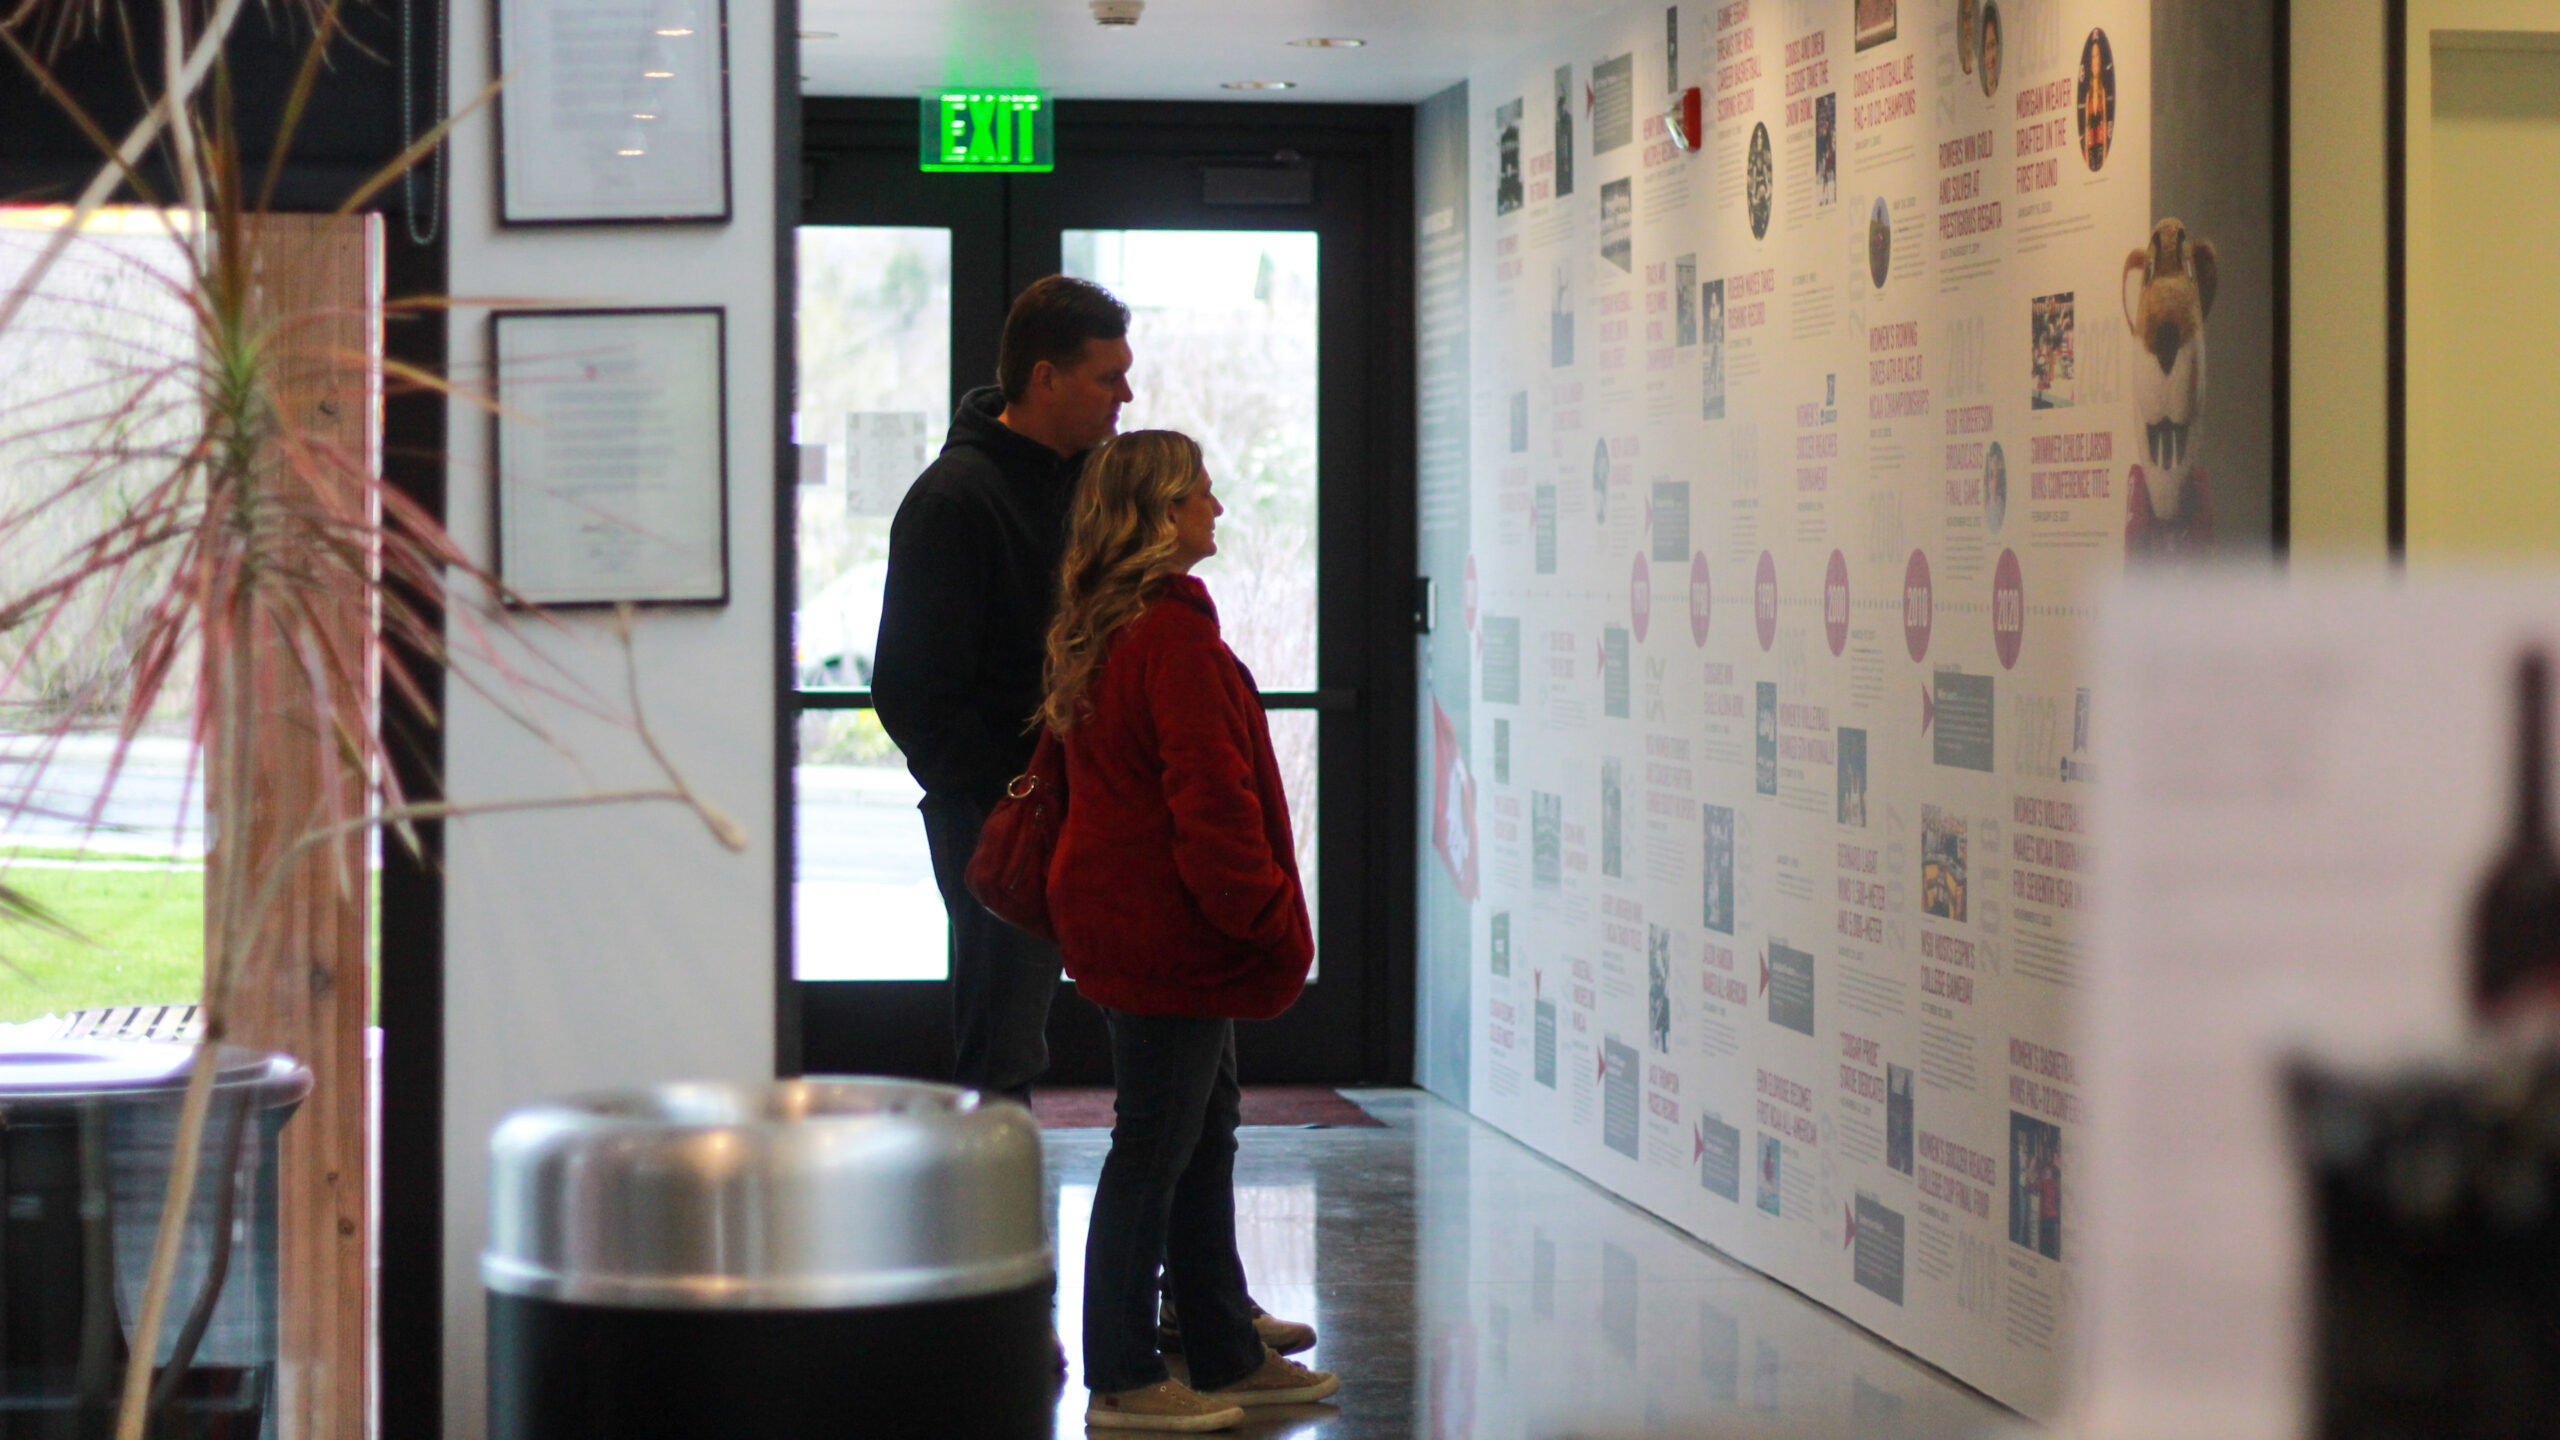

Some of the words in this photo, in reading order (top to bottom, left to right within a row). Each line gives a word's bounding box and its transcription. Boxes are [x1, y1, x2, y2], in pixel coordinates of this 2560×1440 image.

[1854, 69, 1875, 98] COUGAR
[1876, 60, 1902, 91] FOOTBALL
[1903, 54, 1914, 82] ARE
[2016, 87, 2044, 121] MORGAN
[2045, 77, 2072, 113] WEAVER
[941, 94, 1039, 164] EXIT
[2016, 123, 2045, 158] DRAFTED
[2046, 121, 2053, 151] IN
[2054, 117, 2067, 150] THE
[1938, 139, 1963, 169] ROWERS
[1964, 135, 1976, 164] WIN
[1977, 130, 1993, 160] GOLD
[1939, 177, 1951, 205] AND
[1951, 171, 1972, 203] SILVER
[1973, 169, 1981, 198] AT
[2016, 163, 2035, 194] FIRST
[2035, 157, 2058, 193] ROUND
[1938, 206, 1977, 241] PRESTIGIOUS
[1977, 201, 2003, 234] REGATTA
[1869, 324, 1895, 354] WOMEN'S
[1895, 320, 1918, 349] ROWING
[1869, 359, 1887, 387] TAKES
[1898, 355, 1915, 384] PLACE
[1916, 354, 1923, 381] AT
[1884, 389, 1930, 419] CHAMPIONSHIPS
[1945, 408, 1958, 435] BOB
[1958, 404, 1994, 434] ROBERTSON
[1945, 443, 1984, 471] BROADCASTS
[2031, 435, 2062, 464] SWIMMER
[2063, 433, 2085, 463] CHLOE
[2085, 431, 2113, 462] LARSON
[1945, 479, 1962, 506] FINAL
[1962, 478, 1982, 505] GAME
[2031, 471, 2048, 499] WINS
[2048, 469, 2091, 499] CONFERENCE
[2091, 468, 2111, 499] TITLE
[1757, 582, 1775, 619] 1990
[1827, 584, 1846, 623] 2000
[1906, 587, 1929, 627] 2010
[1996, 588, 2021, 632] 2020
[2014, 795, 2044, 828] WOMEN'S
[1837, 842, 1864, 872] BERNARD
[1864, 848, 1878, 875] LAGAT
[2013, 832, 2035, 864] MAKES
[2035, 835, 2053, 866] NCAA
[1837, 876, 1850, 904] WINS
[2013, 869, 2026, 902] FOR
[2026, 871, 2055, 907] SEVENTH
[2056, 876, 2074, 910] YEAR
[1837, 908, 1849, 936] AND
[1921, 929, 1933, 957] WSU
[1934, 933, 1952, 962] HOSTS
[1952, 938, 1976, 969] ESPN'S
[1921, 964, 1946, 997] COLLEGE
[1946, 973, 1974, 1006] GAMEDAY
[2009, 1037, 2038, 1071] WOMEN'S
[2009, 1073, 2026, 1105] WINS
[1918, 1130, 1944, 1164] WOMEN'S
[1944, 1136, 1969, 1175] SOCCER
[1969, 1144, 1996, 1187] REACHES
[1918, 1164, 1943, 1198] COLLEGE
[1943, 1172, 1956, 1204] CUP
[1956, 1175, 1973, 1213] FINAL
[1973, 1185, 1990, 1221] FOUR
